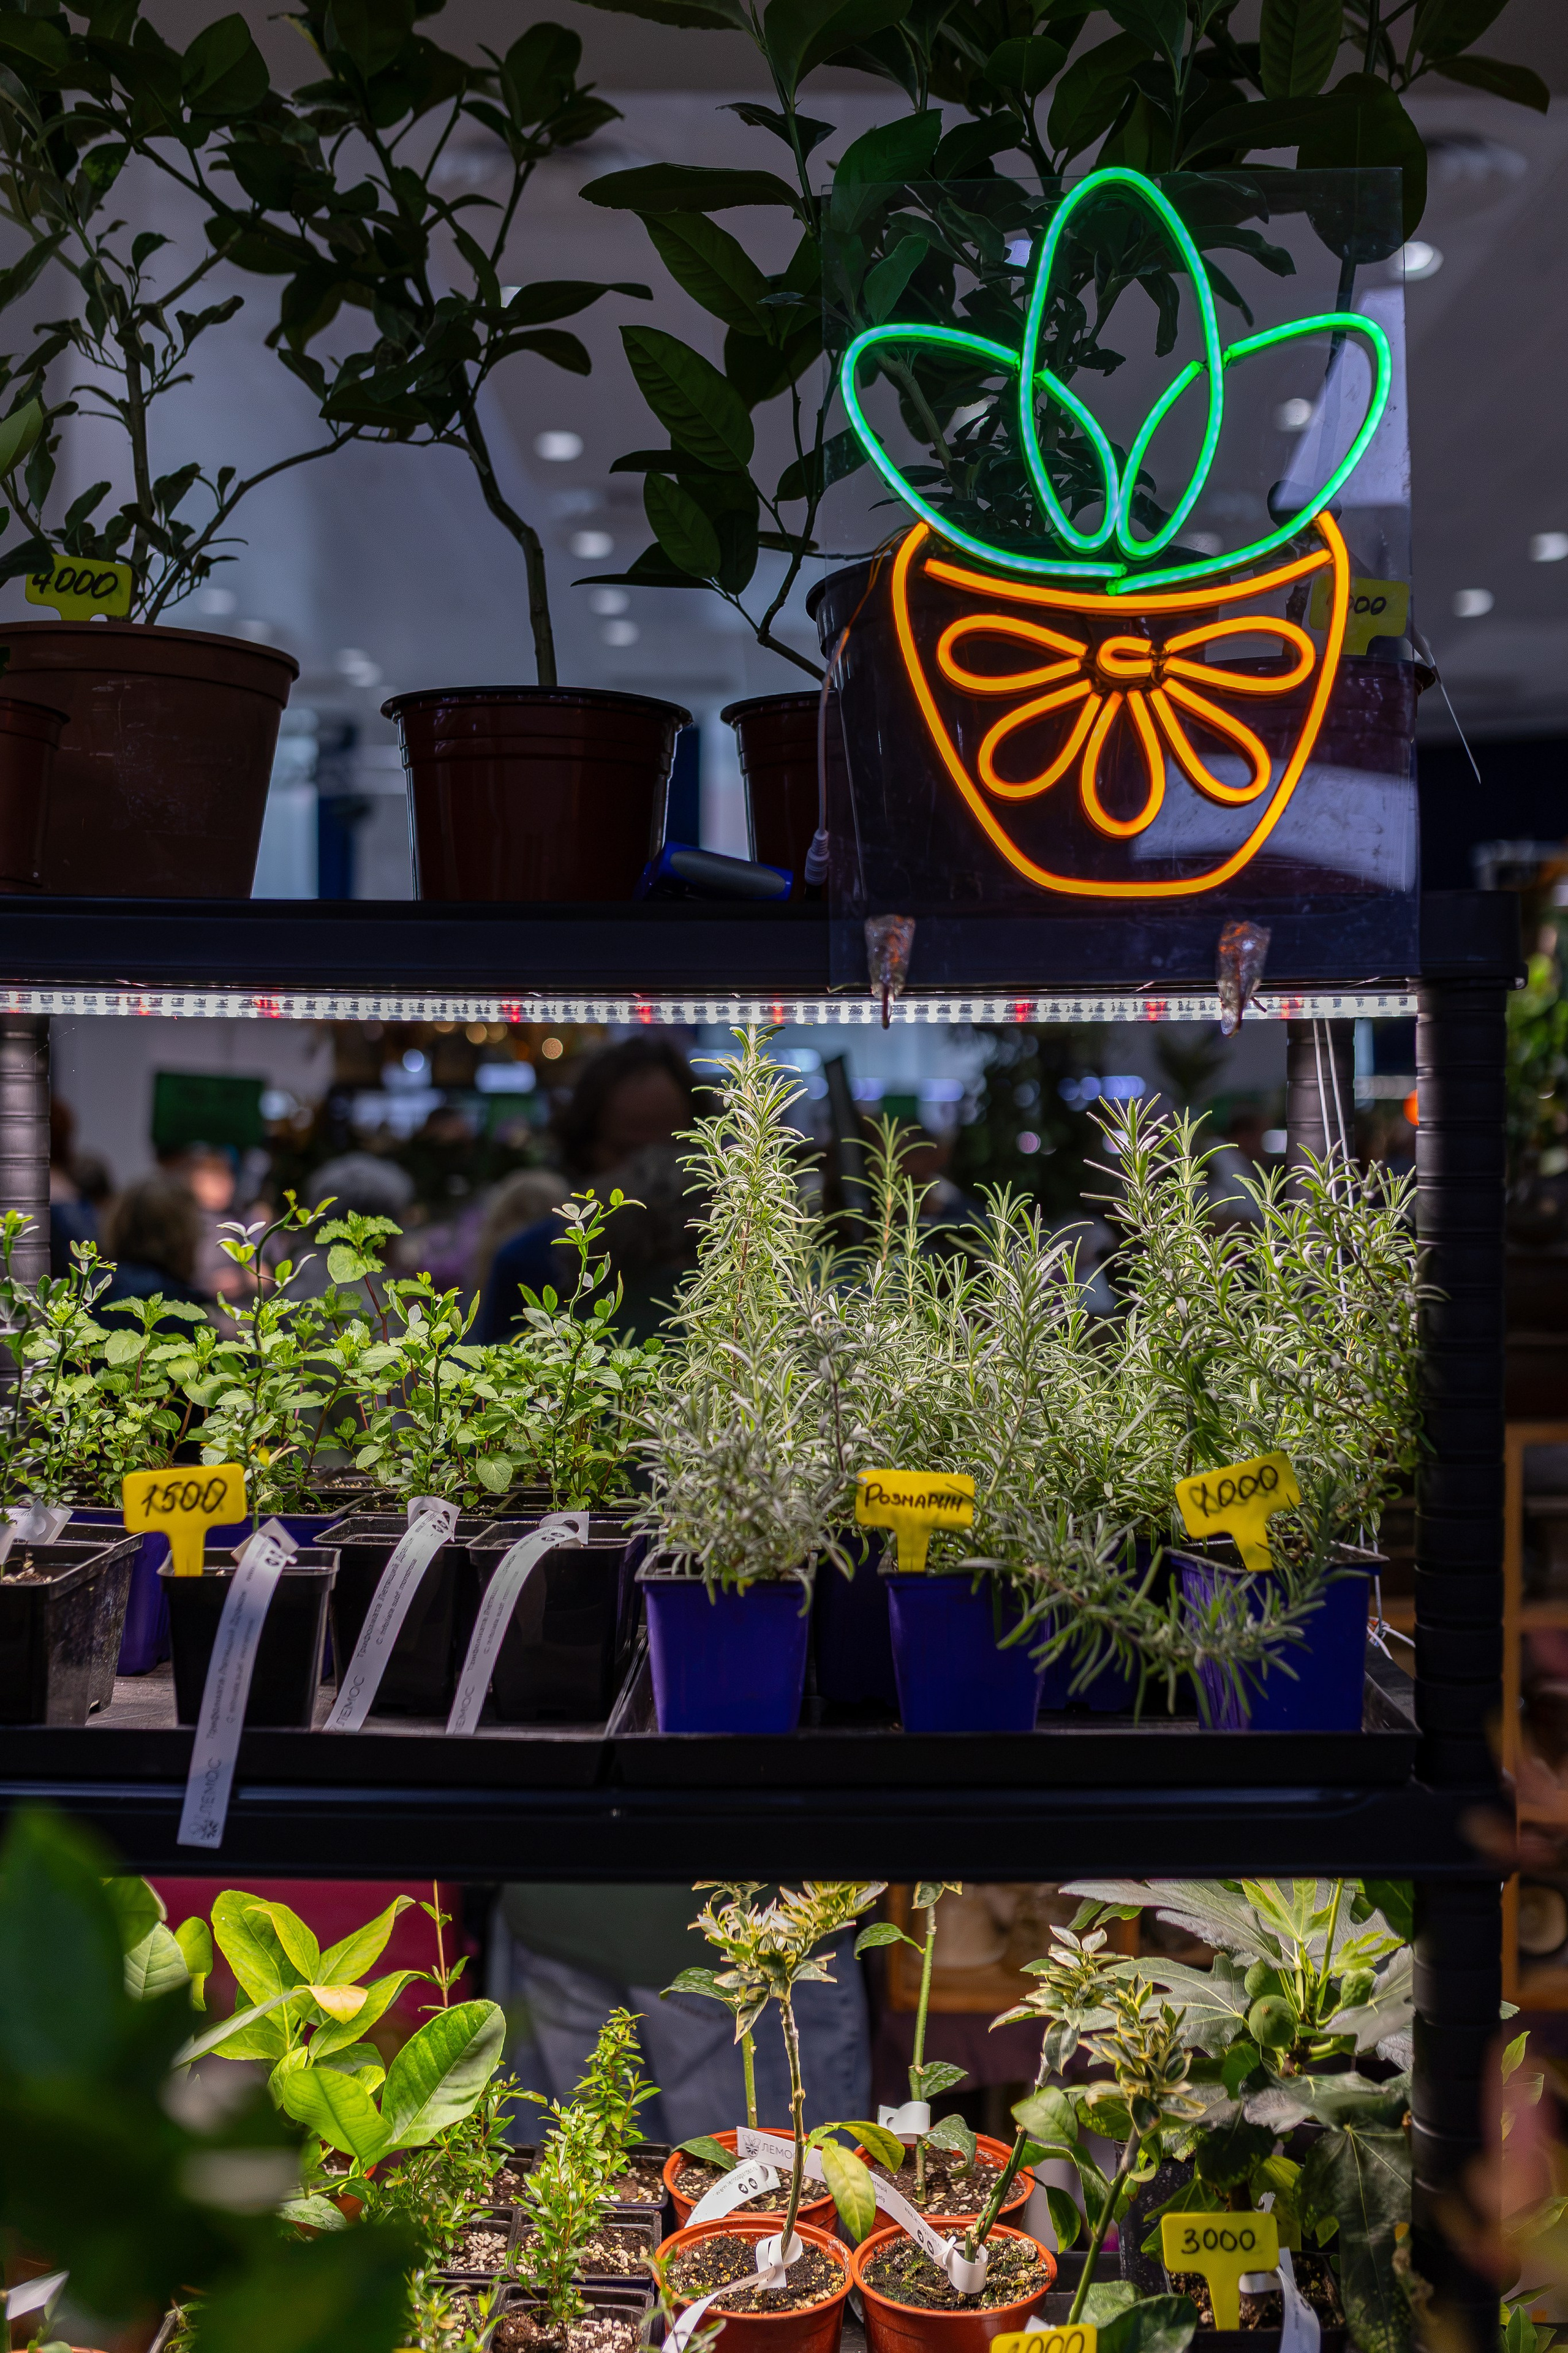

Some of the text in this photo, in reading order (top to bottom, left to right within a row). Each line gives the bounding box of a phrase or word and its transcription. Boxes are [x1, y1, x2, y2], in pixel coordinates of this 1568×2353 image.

[141, 1477, 227, 1517] 1500
[336, 1675, 365, 1728] ЛЕМОС
[761, 2142, 796, 2159] ЛЕМО
[1181, 2227, 1256, 2254] 3000
